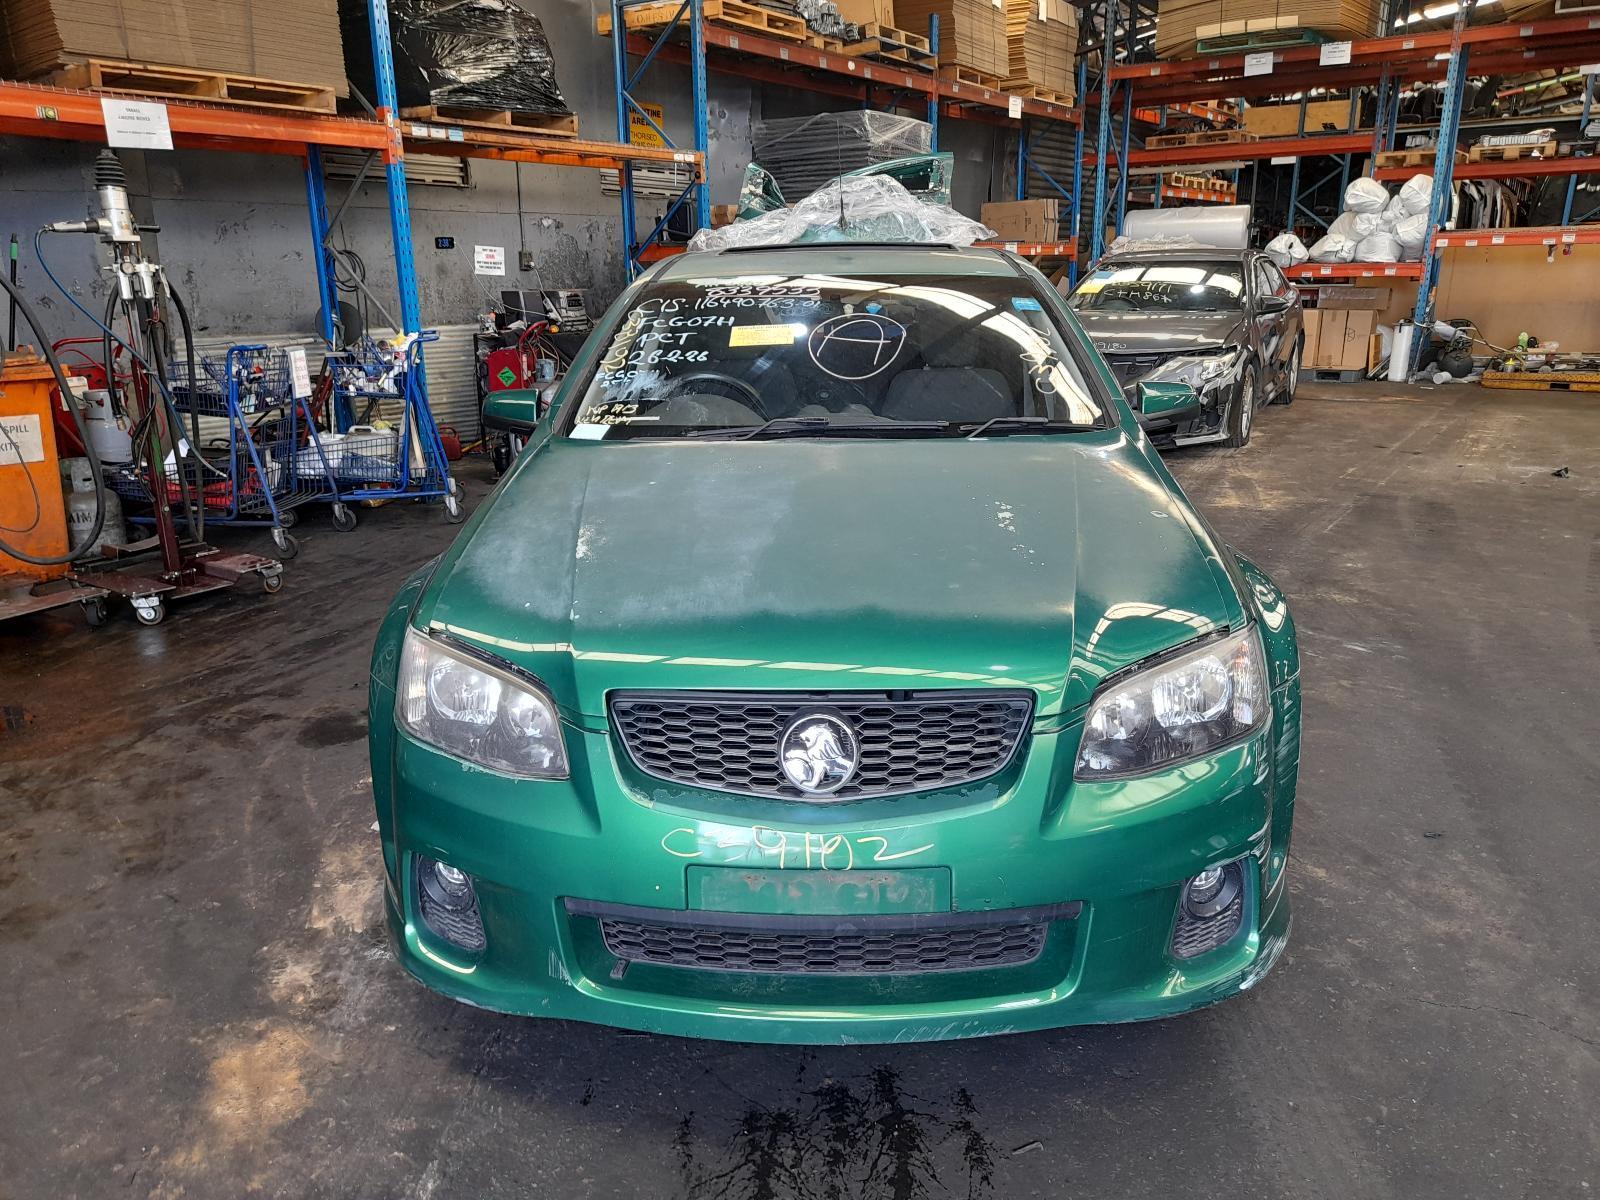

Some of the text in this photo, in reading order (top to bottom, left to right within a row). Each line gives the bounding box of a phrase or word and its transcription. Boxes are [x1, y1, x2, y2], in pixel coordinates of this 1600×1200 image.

[635, 332, 698, 348] PCT
[816, 319, 892, 366] A
[3, 425, 29, 434] SPILL
